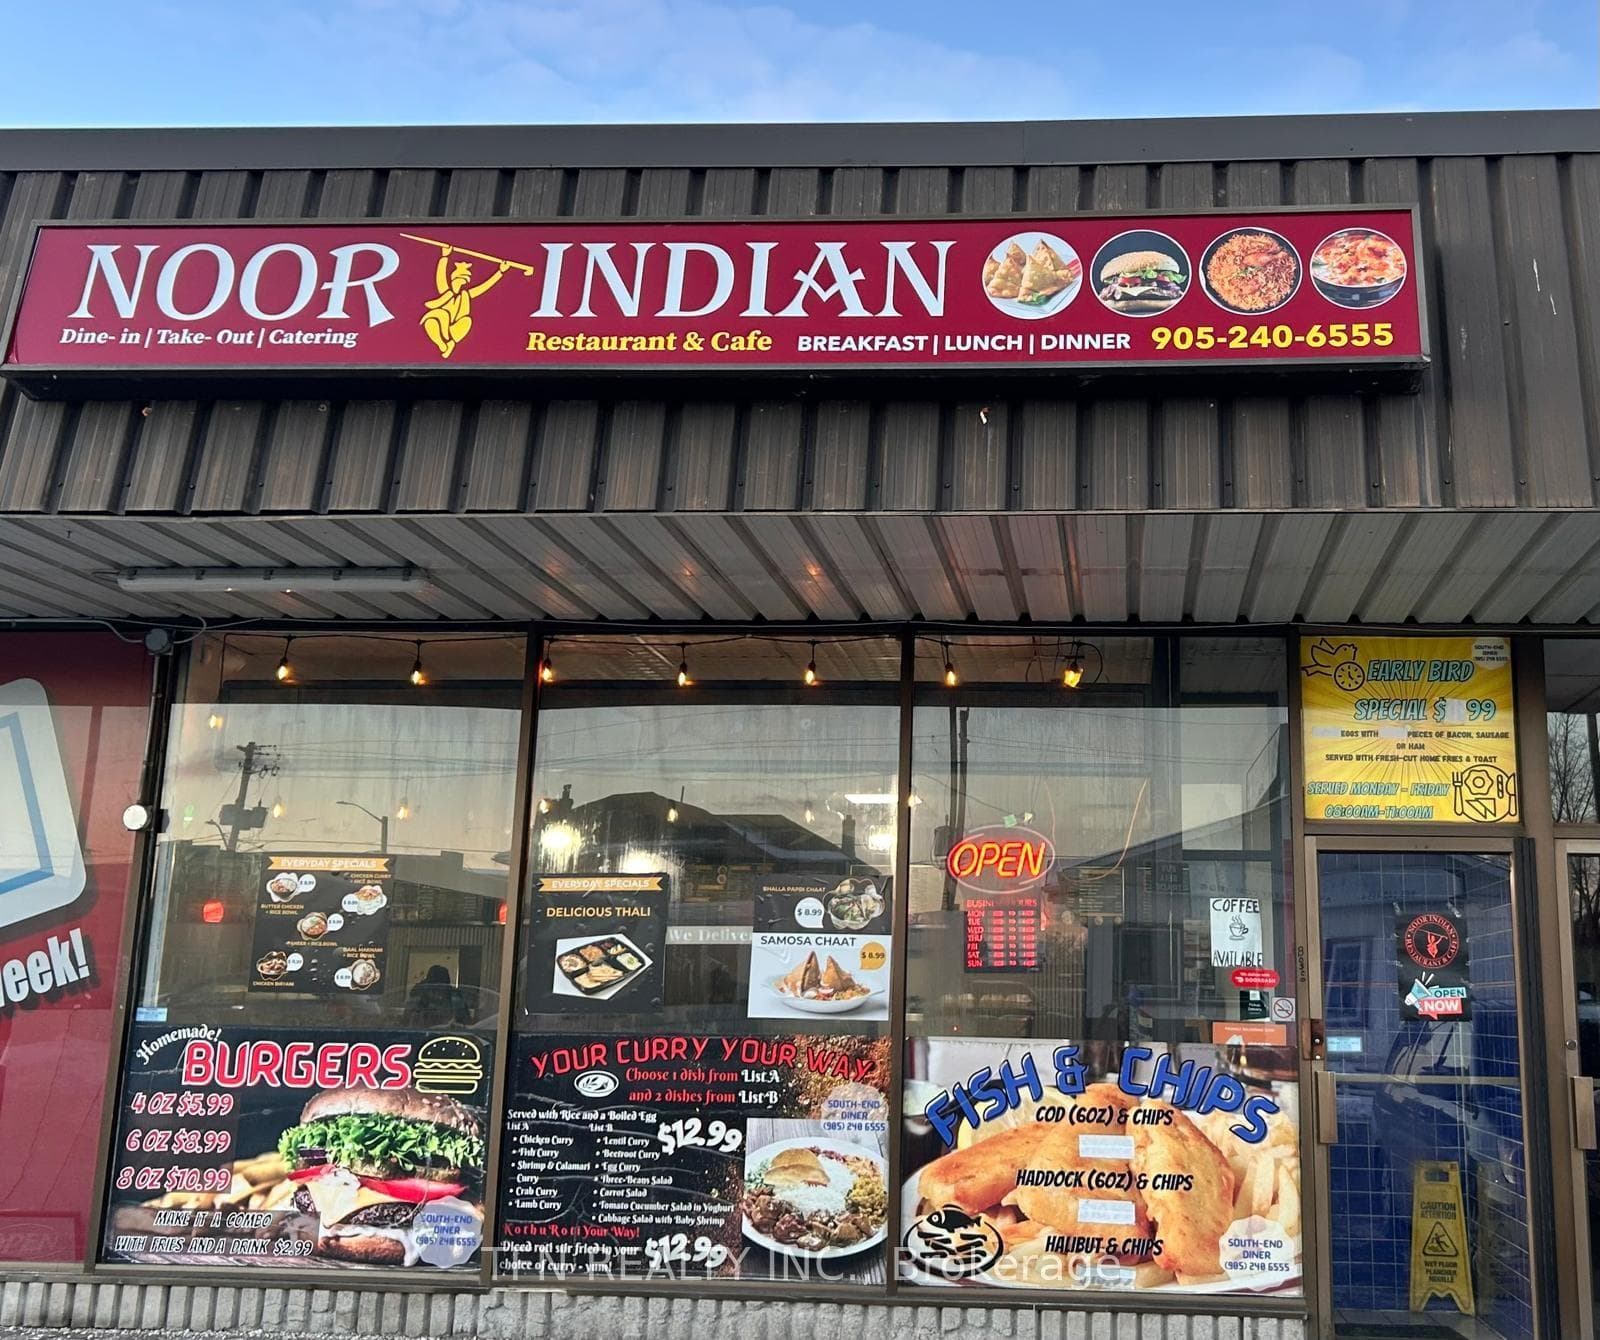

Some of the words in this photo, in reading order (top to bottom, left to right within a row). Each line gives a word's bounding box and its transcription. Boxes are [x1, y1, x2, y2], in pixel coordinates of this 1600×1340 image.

[67, 242, 400, 328] NOOR
[529, 239, 957, 319] INDIAN
[60, 327, 117, 346] Dine-
[119, 328, 141, 346] in
[156, 328, 213, 347] Take-
[216, 328, 254, 347] Out
[268, 328, 358, 349] Catering
[526, 331, 677, 352] Restaurant
[682, 331, 704, 352] &
[711, 330, 773, 352] Cafe
[797, 334, 932, 353] BREAKFAST
[944, 334, 1022, 352] LUNCH
[1041, 333, 1131, 351] DINNER
[1151, 323, 1393, 350] 905-240-6555
[1367, 659, 1427, 682] EARLY
[1428, 660, 1475, 682] BIRD
[1354, 698, 1428, 721] SPECIAL
[1341, 730, 1359, 738] EGGS
[1361, 730, 1379, 738] WITH
[1407, 731, 1433, 739] PIECES
[1435, 731, 1444, 739] OF
[1475, 731, 1510, 739] SAUSAGE
[1325, 753, 1353, 762] SERVED
[1356, 754, 1374, 762] WITH
[1375, 754, 1418, 762] FRESH-CUT
[1419, 754, 1441, 762] HOME
[1442, 754, 1463, 762] FRIES
[1473, 755, 1498, 763] TOAST
[1307, 782, 1349, 795] SERVED
[1350, 782, 1400, 796] MONDAY
[1410, 783, 1451, 796] FRIDAY
[281, 857, 330, 868] EVERYDAY
[332, 857, 377, 868] SPECIALS
[951, 841, 1047, 878] OPEN
[552, 880, 602, 888] EVERYDAY
[605, 880, 649, 888] SPECIALS
[546, 907, 612, 917] DELICIOUS
[615, 907, 651, 917] THALI
[1212, 899, 1260, 913] COFFEE
[667, 928, 692, 942] We
[760, 936, 812, 946] SAMOSA
[815, 936, 856, 946] CHAAT
[1212, 950, 1263, 967] AVAILABLE
[0, 928, 90, 1007] eek!
[1434, 989, 1465, 998] OPEN
[1424, 1000, 1459, 1011] NOW
[135, 1023, 223, 1065] Homemade!
[181, 1040, 412, 1090] BURGERS
[531, 1043, 607, 1079] YOUR
[615, 1037, 710, 1065] CURRY
[722, 1038, 797, 1068] YOUR
[806, 1047, 876, 1083] WAY
[625, 1068, 669, 1083] Choose
[680, 1068, 705, 1084] dish
[707, 1068, 739, 1084] from
[741, 1069, 767, 1084] List
[767, 1070, 780, 1084] A
[131, 1092, 145, 1114] 4
[147, 1092, 177, 1115] OZ
[177, 1092, 234, 1116] $5.99
[629, 1089, 652, 1103] and
[655, 1091, 662, 1102] 2
[665, 1089, 701, 1105] dishes
[704, 1089, 736, 1105] from
[738, 1090, 764, 1105] List
[763, 1091, 779, 1105] B
[923, 1051, 1043, 1148] FISH
[1052, 1045, 1088, 1096] &
[1118, 1046, 1280, 1145] CHIPS
[507, 1109, 537, 1120] Served
[538, 1110, 558, 1120] with
[559, 1110, 580, 1122] Rice
[582, 1110, 599, 1120] and
[607, 1111, 637, 1121] Boiled
[638, 1112, 657, 1123] Egg
[1035, 1105, 1064, 1123] COD
[1117, 1108, 1130, 1124] &
[1132, 1108, 1173, 1126] CHIPS
[126, 1129, 141, 1152] 6
[142, 1130, 171, 1152] OZ
[172, 1130, 232, 1154] $8.99
[519, 1135, 550, 1145] Chicken
[551, 1136, 574, 1146] Curry
[657, 1117, 743, 1155] $12.99
[517, 1148, 537, 1158] Fish
[538, 1149, 559, 1159] Curry
[116, 1168, 133, 1189] 8
[134, 1168, 162, 1190] OZ
[164, 1168, 232, 1192] $10.99
[1016, 1169, 1083, 1187] HADDOCK
[1136, 1173, 1149, 1190] &
[1152, 1174, 1193, 1191] CHIPS
[515, 1187, 534, 1196] Crab
[535, 1187, 558, 1198] Curry
[515, 1200, 537, 1209] Lamb
[538, 1201, 562, 1211] Curry
[1420, 1201, 1456, 1211] CAUTION
[153, 1211, 191, 1227] MAKE
[193, 1212, 208, 1227] IT
[210, 1212, 223, 1227] A
[225, 1212, 273, 1228] COMBO
[598, 1214, 628, 1225] Cabbage
[629, 1214, 654, 1224] Salad
[655, 1215, 673, 1224] with
[674, 1215, 695, 1226] Baby
[696, 1216, 725, 1228] Shrimp
[115, 1236, 146, 1251] WITH
[150, 1236, 185, 1253] FRIES
[189, 1237, 213, 1253] AND
[214, 1238, 225, 1253] A
[229, 1238, 269, 1254] DRINK
[273, 1239, 314, 1256] $2.99
[645, 1233, 728, 1270] $12.99
[1045, 1235, 1101, 1254] HALIBUT
[1107, 1238, 1119, 1254] &
[1122, 1238, 1163, 1256] CHIPS
[1228, 1238, 1283, 1249] SOUTH-END
[1242, 1250, 1271, 1260] DINER
[1224, 1261, 1247, 1271] (905)
[1249, 1262, 1266, 1271] 240
[1268, 1262, 1290, 1272] 6555
